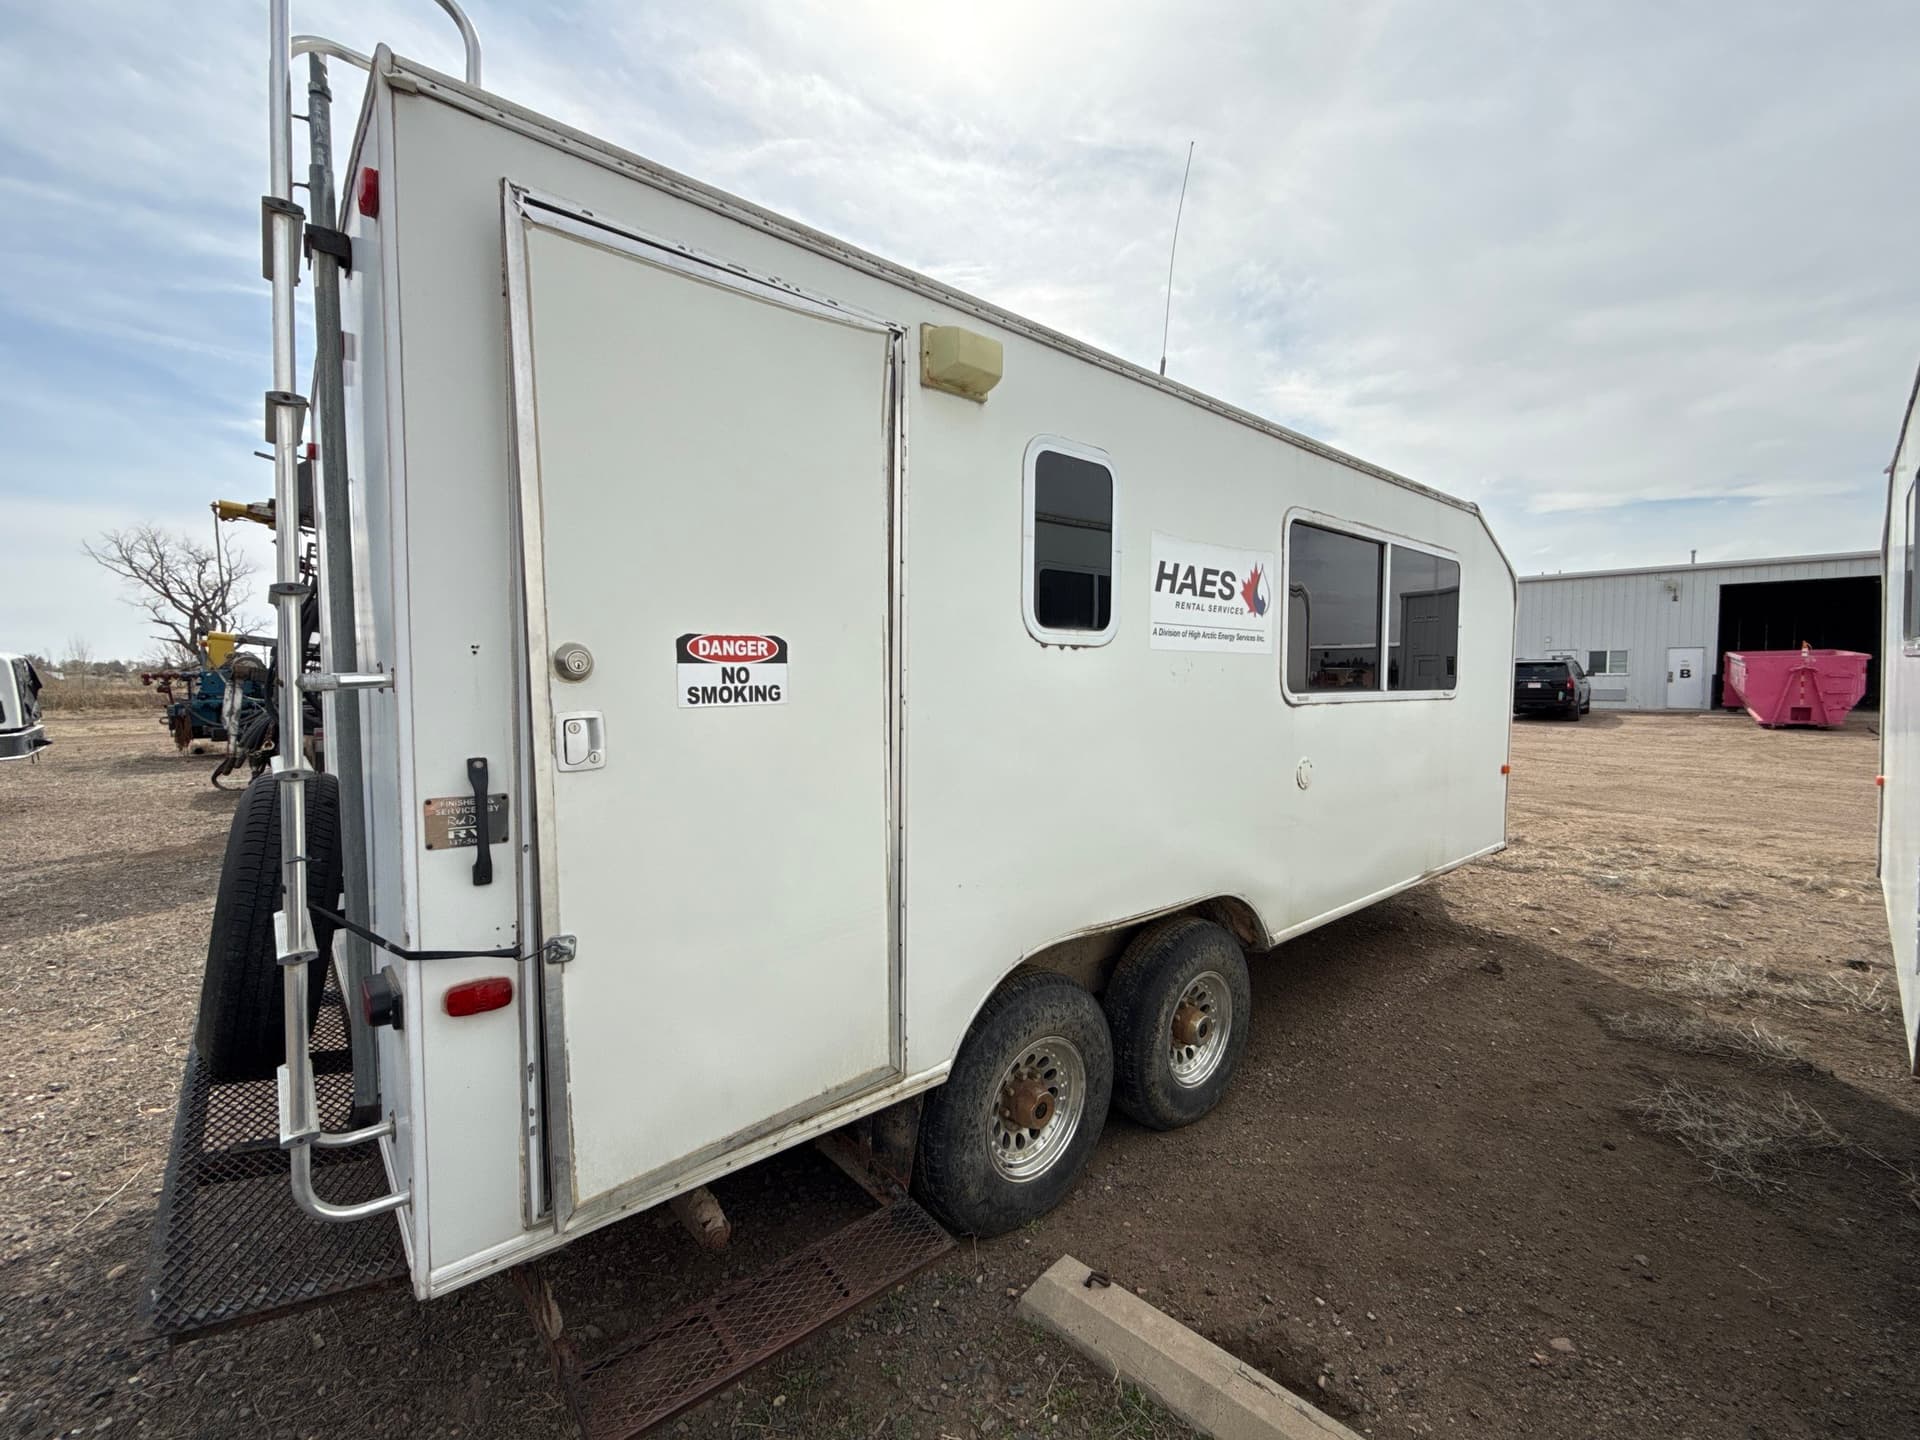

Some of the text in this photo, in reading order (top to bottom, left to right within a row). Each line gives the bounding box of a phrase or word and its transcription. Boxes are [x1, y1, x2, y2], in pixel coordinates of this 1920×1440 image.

[1154, 560, 1237, 601] HAES
[1175, 600, 1244, 616] RENTAL SERVICES
[1152, 627, 1157, 636] A
[1159, 627, 1180, 638] Division
[1182, 629, 1188, 638] of
[1188, 630, 1201, 641] High
[1218, 631, 1235, 642] Energy
[1236, 633, 1256, 642] Services
[698, 639, 769, 656] DANGER
[721, 666, 750, 685] NO
[1680, 669, 1691, 679] B
[687, 684, 781, 705] SMOKING
[435, 806, 476, 816] SERVICE
[440, 799, 476, 807] FINISHE
